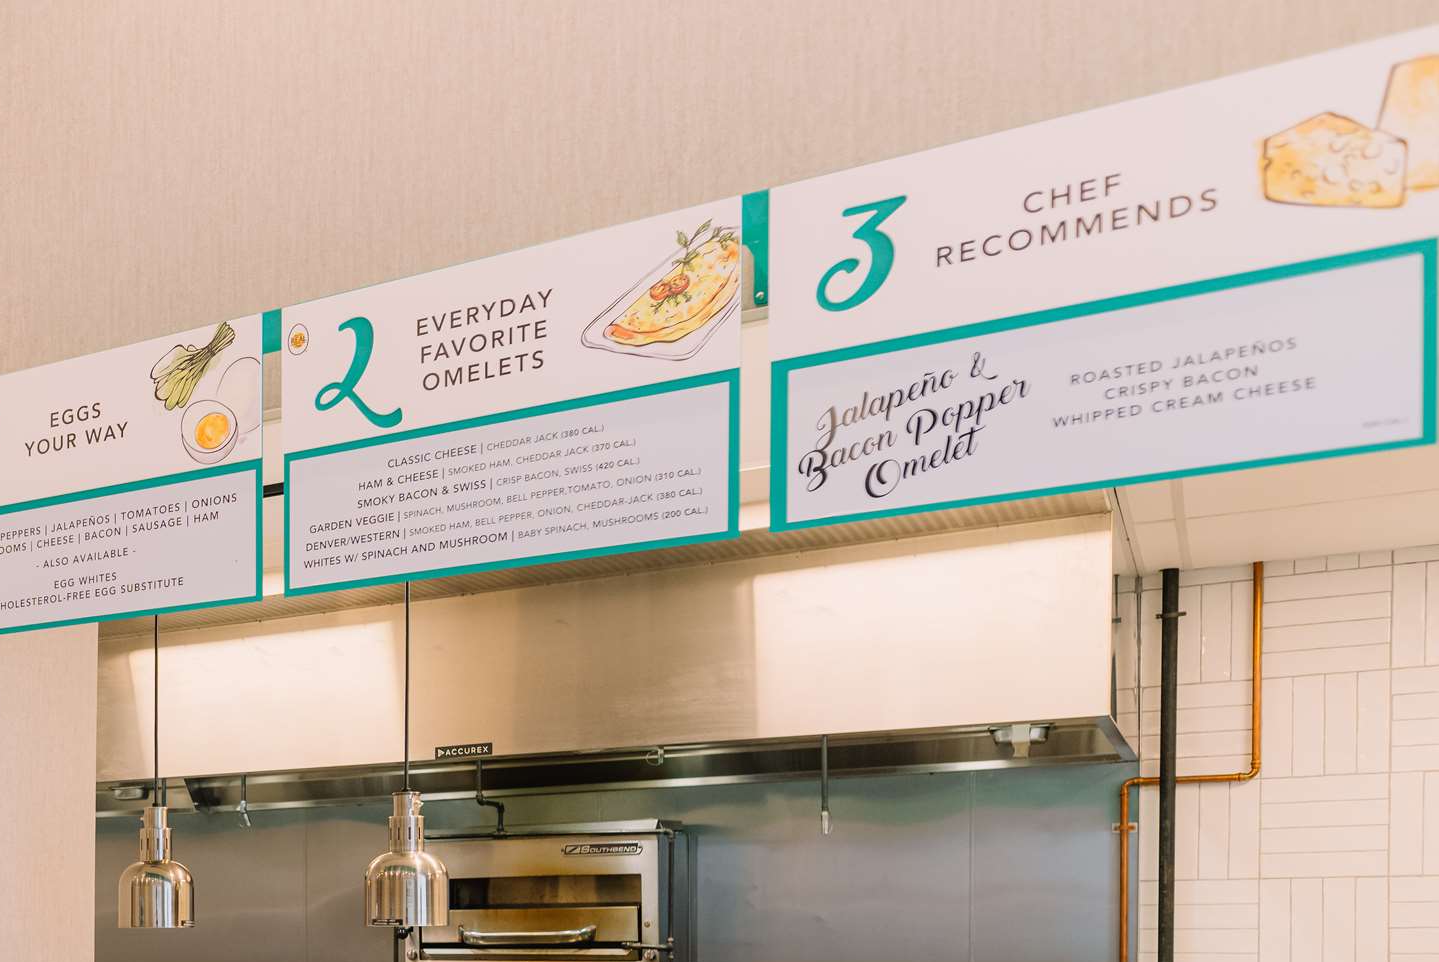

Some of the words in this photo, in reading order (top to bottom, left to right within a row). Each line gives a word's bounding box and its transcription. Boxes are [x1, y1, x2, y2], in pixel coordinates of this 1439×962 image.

[1022, 173, 1120, 214] CHEF
[936, 188, 1217, 267] RECOMMENDS
[816, 195, 907, 313] 3
[416, 288, 553, 337] EVERYDAY
[420, 319, 547, 364] FAVORITE
[1070, 360, 1163, 384] ROASTED
[1171, 336, 1297, 369] JALAPEÑOS
[314, 316, 403, 428] 2
[421, 349, 544, 391] OMELETS
[1104, 380, 1172, 400] CRISPY
[1182, 366, 1257, 388] BACON
[49, 401, 101, 428] EGGS
[815, 368, 959, 452] Jalapeño
[970, 351, 998, 380] &
[1053, 404, 1142, 427] WHIPPED
[1151, 391, 1223, 413] CREAM
[1233, 376, 1313, 400] CHEESE
[24, 432, 77, 457] YOUR
[84, 421, 128, 445] WAY
[386, 451, 432, 468] CLASSIC
[433, 444, 477, 460] CHEESE
[485, 436, 532, 451] CHEDDAR
[533, 431, 560, 443] JACK
[559, 427, 580, 438] (380
[580, 425, 605, 435] CAL.)
[798, 429, 897, 492] Bacon
[906, 378, 1031, 446] Popper
[356, 493, 396, 509] SMOKY
[397, 487, 438, 502] BACON
[440, 485, 450, 495] &
[452, 478, 487, 493] SWISS
[495, 474, 523, 484] CRISP
[563, 463, 593, 476] SWISS
[594, 460, 615, 471] (420
[615, 457, 641, 467] CAL.)
[358, 478, 383, 491] HAM
[385, 476, 394, 486] &
[396, 468, 439, 484] CHEESE
[448, 461, 487, 475] SMOKED
[515, 449, 562, 465] CHEDDAR
[563, 445, 589, 457] JACK
[591, 442, 611, 452] (370
[612, 439, 636, 449] CAL.)
[864, 425, 986, 498] Omelet
[0, 525, 41, 541] PEPPERS
[50, 514, 110, 533] JALAPEÑOS
[119, 501, 180, 520] TOMATOES
[190, 492, 237, 509] ONIONS
[304, 529, 400, 552] DENVER/WESTERN
[408, 523, 448, 535] SMOKED
[474, 517, 497, 527] BELL
[655, 490, 677, 501] (380
[677, 488, 703, 497] CAL.)
[308, 519, 352, 534] GARDEN
[354, 511, 395, 526] VEGGIE
[505, 493, 528, 504] BELL
[615, 473, 652, 488] ONION
[654, 470, 675, 481] (310
[676, 468, 701, 478] CAL.)
[35, 533, 74, 549] CHEESE
[83, 526, 121, 541] BACON
[131, 516, 183, 533] SAUSAGE
[193, 510, 219, 523] HAM
[302, 555, 341, 569] WHITES
[343, 553, 358, 563] W/
[360, 545, 408, 561] SPINACH
[410, 541, 436, 553] AND
[438, 531, 508, 550] MUSHROOM
[517, 527, 543, 538] BABY
[592, 511, 659, 528] MUSHROOMS
[661, 509, 682, 519] (200
[683, 507, 707, 516] CAL.)
[42, 556, 69, 569] ALSO
[72, 546, 129, 564] AVAILABLE
[53, 577, 75, 590] EGG
[77, 571, 117, 585] WHITES
[94, 585, 117, 598] EGG
[120, 576, 184, 594] SUBSTITUTE
[446, 744, 489, 757] ACCUREX
